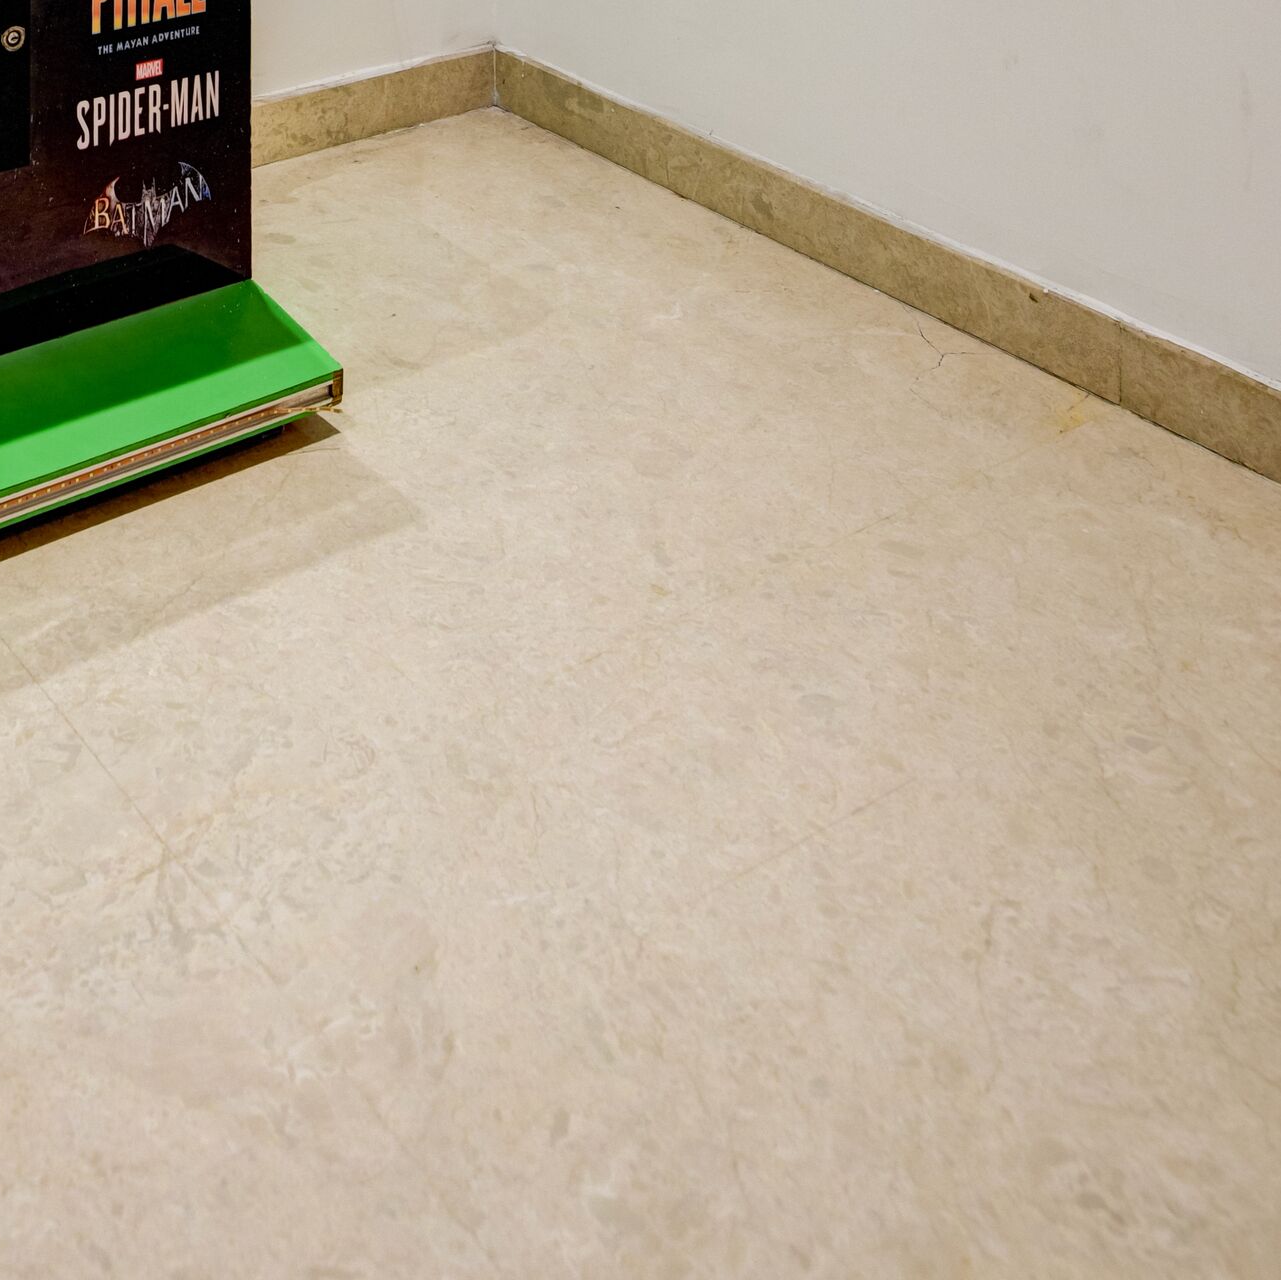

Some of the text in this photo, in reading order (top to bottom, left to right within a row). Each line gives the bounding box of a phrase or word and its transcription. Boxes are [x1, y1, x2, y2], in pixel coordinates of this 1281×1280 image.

[98, 25, 200, 55] THE MAYAN ADVENTURE
[136, 59, 163, 80] MARVEL
[76, 70, 220, 150] SPIDER-MAN
[84, 176, 203, 247] BATMAN
